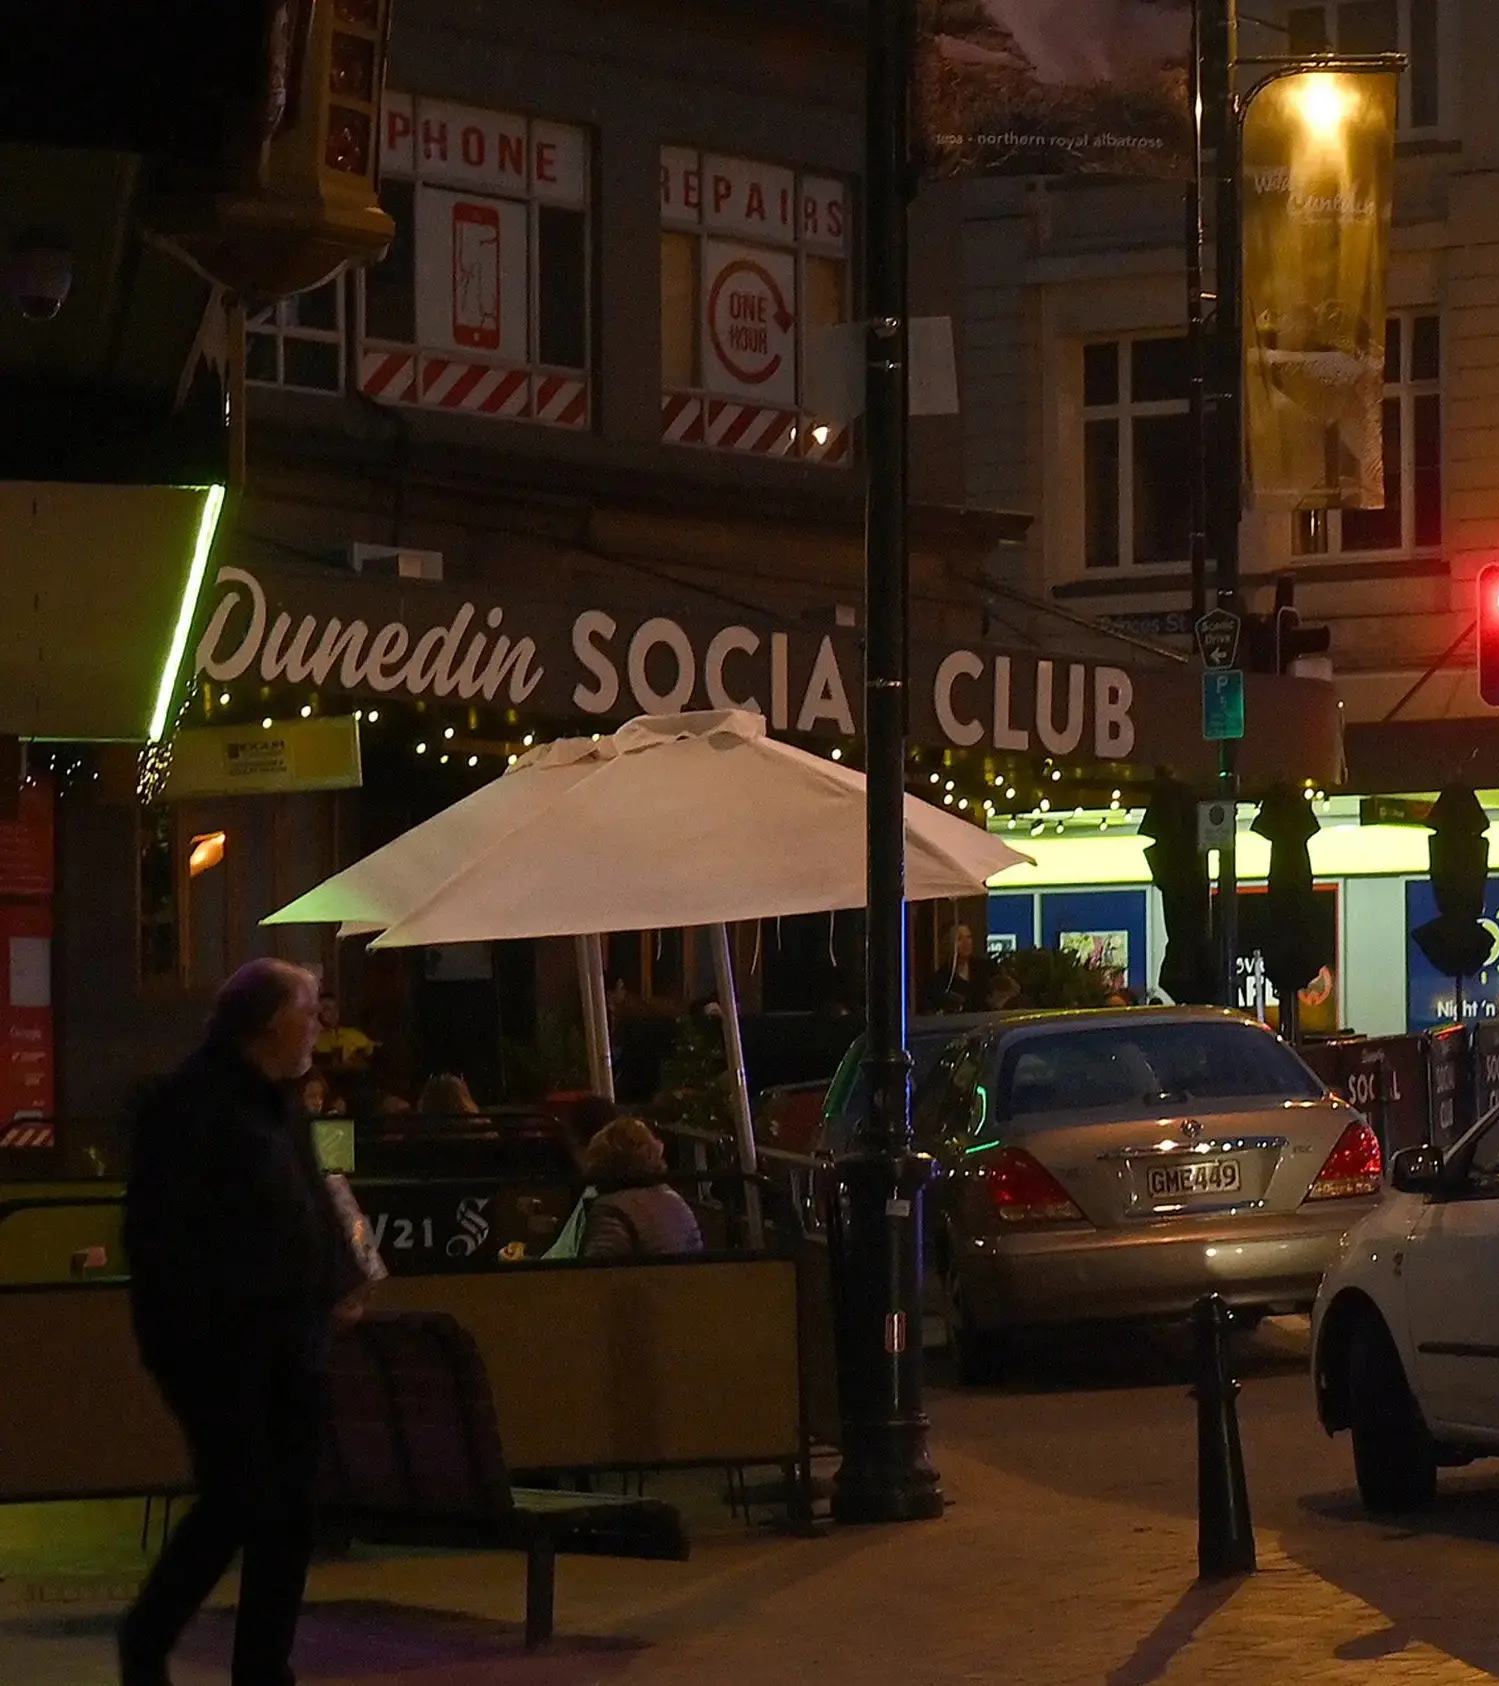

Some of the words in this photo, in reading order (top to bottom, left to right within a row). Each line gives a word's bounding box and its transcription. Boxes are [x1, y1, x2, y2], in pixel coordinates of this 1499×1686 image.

[387, 112, 558, 182] PHONE
[977, 130, 1046, 145] northern
[1049, 133, 1089, 151] royal
[1093, 132, 1164, 149] albatross
[729, 292, 769, 322] ONE
[728, 326, 769, 355] HOUR
[197, 566, 545, 706] Dunedin
[571, 609, 856, 735] SOCIA
[934, 650, 1136, 759] CLUB
[1437, 1000, 1478, 1021] Night
[1348, 1071, 1402, 1104] SOCL
[1152, 1164, 1237, 1193] GME449
